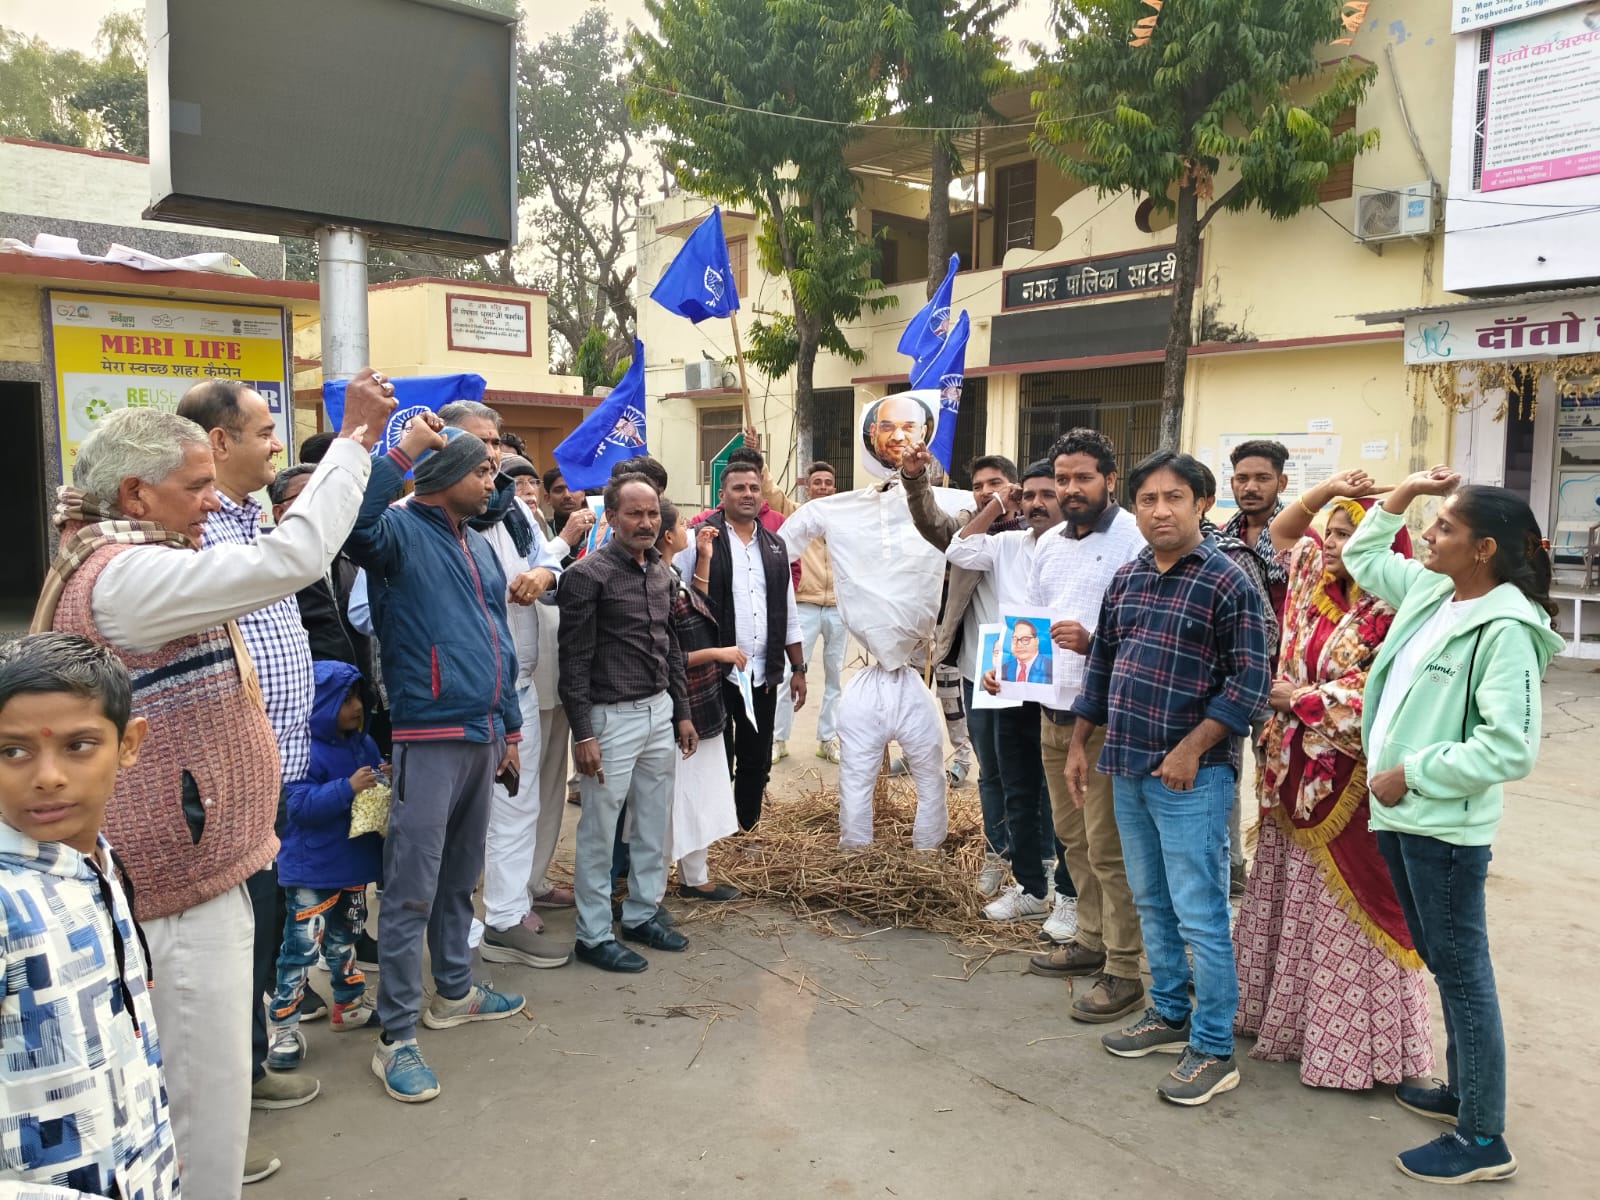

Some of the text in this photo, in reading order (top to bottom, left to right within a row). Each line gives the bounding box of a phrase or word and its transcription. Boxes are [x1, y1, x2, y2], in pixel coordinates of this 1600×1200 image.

[1462, 6, 1472, 14] Dr.
[1475, 1, 1493, 10] Man
[1496, 46, 1528, 64] दांतों
[1531, 42, 1552, 56] का
[1022, 277, 1058, 302] नगर
[1066, 266, 1119, 295] पालिका
[100, 333, 242, 360] MERI LIFE
[101, 357, 125, 373] मेरा
[129, 362, 168, 375] स्वच्छ
[172, 363, 199, 377] शहर
